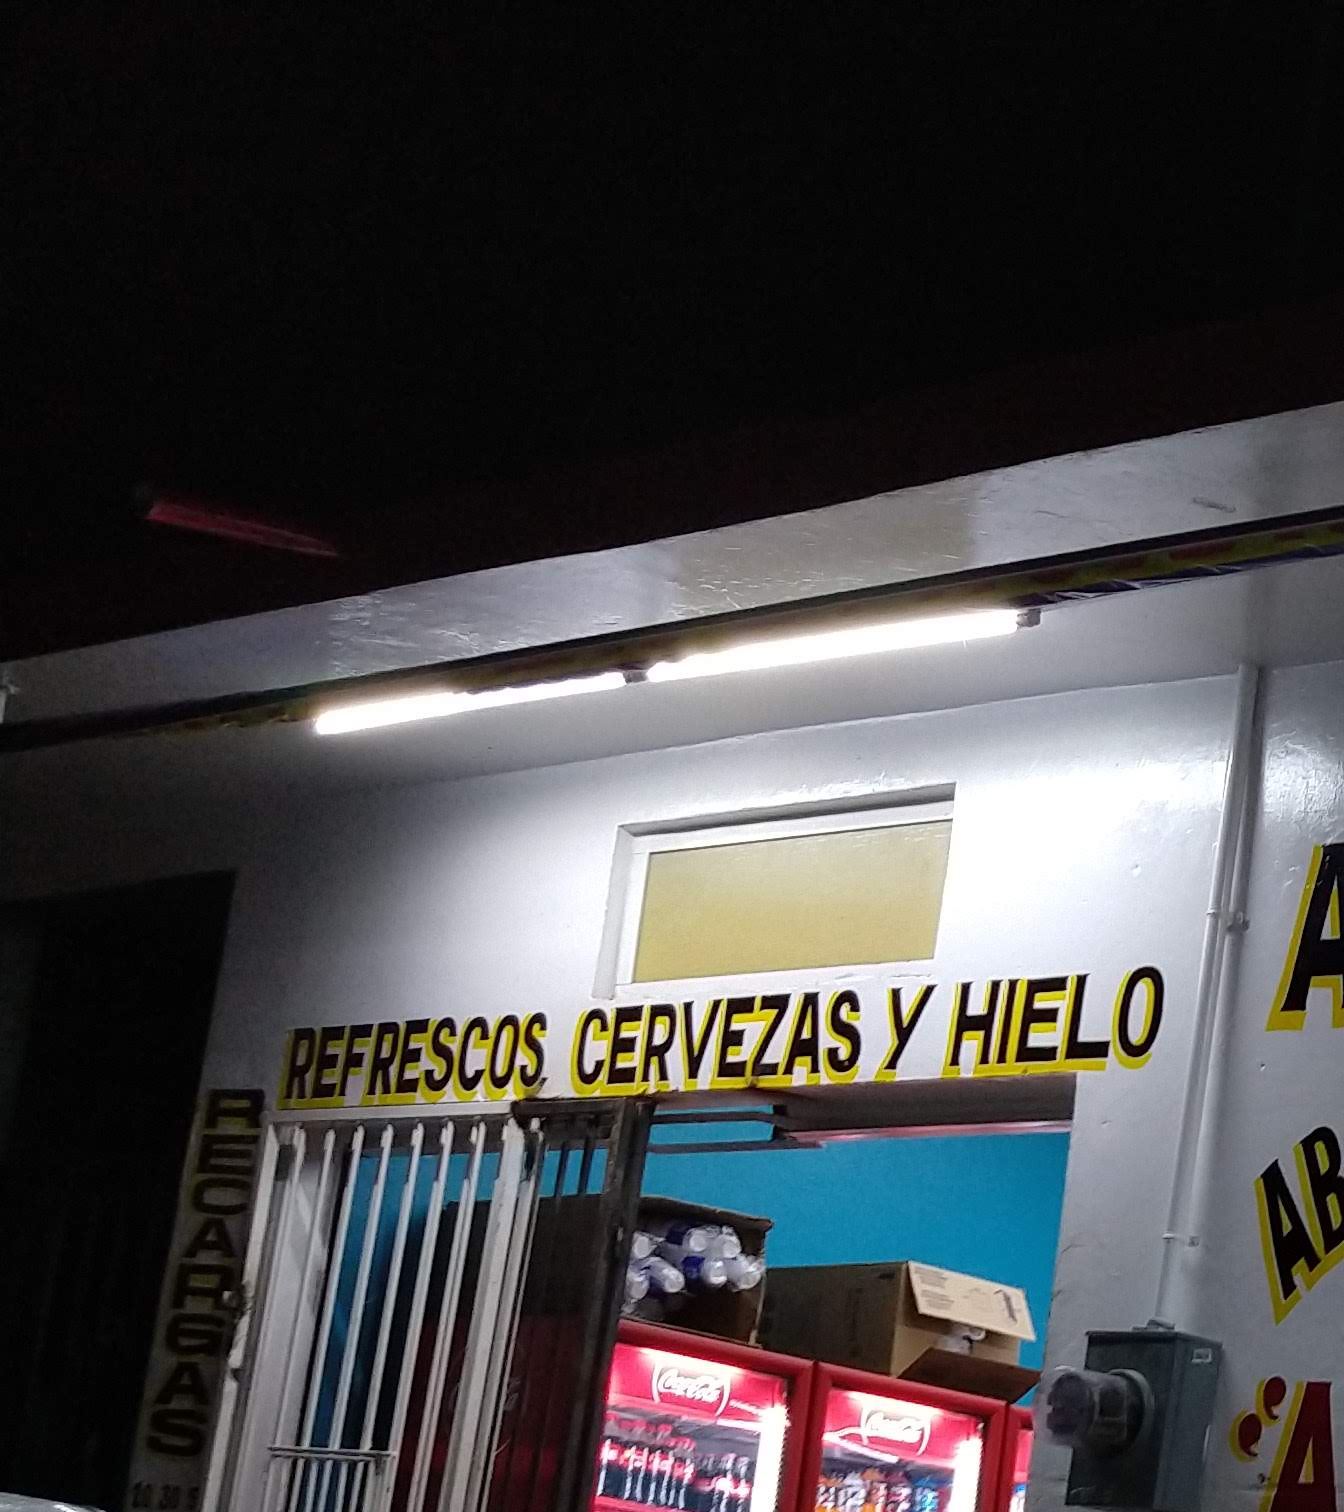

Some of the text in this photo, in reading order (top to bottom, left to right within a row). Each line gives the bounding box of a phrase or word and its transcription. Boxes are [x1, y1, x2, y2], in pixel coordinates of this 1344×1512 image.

[570, 989, 861, 1096] CERVEZAS
[875, 984, 938, 1082] Y
[941, 966, 1165, 1078] HIELO
[146, 1088, 266, 1458] RECARGAS
